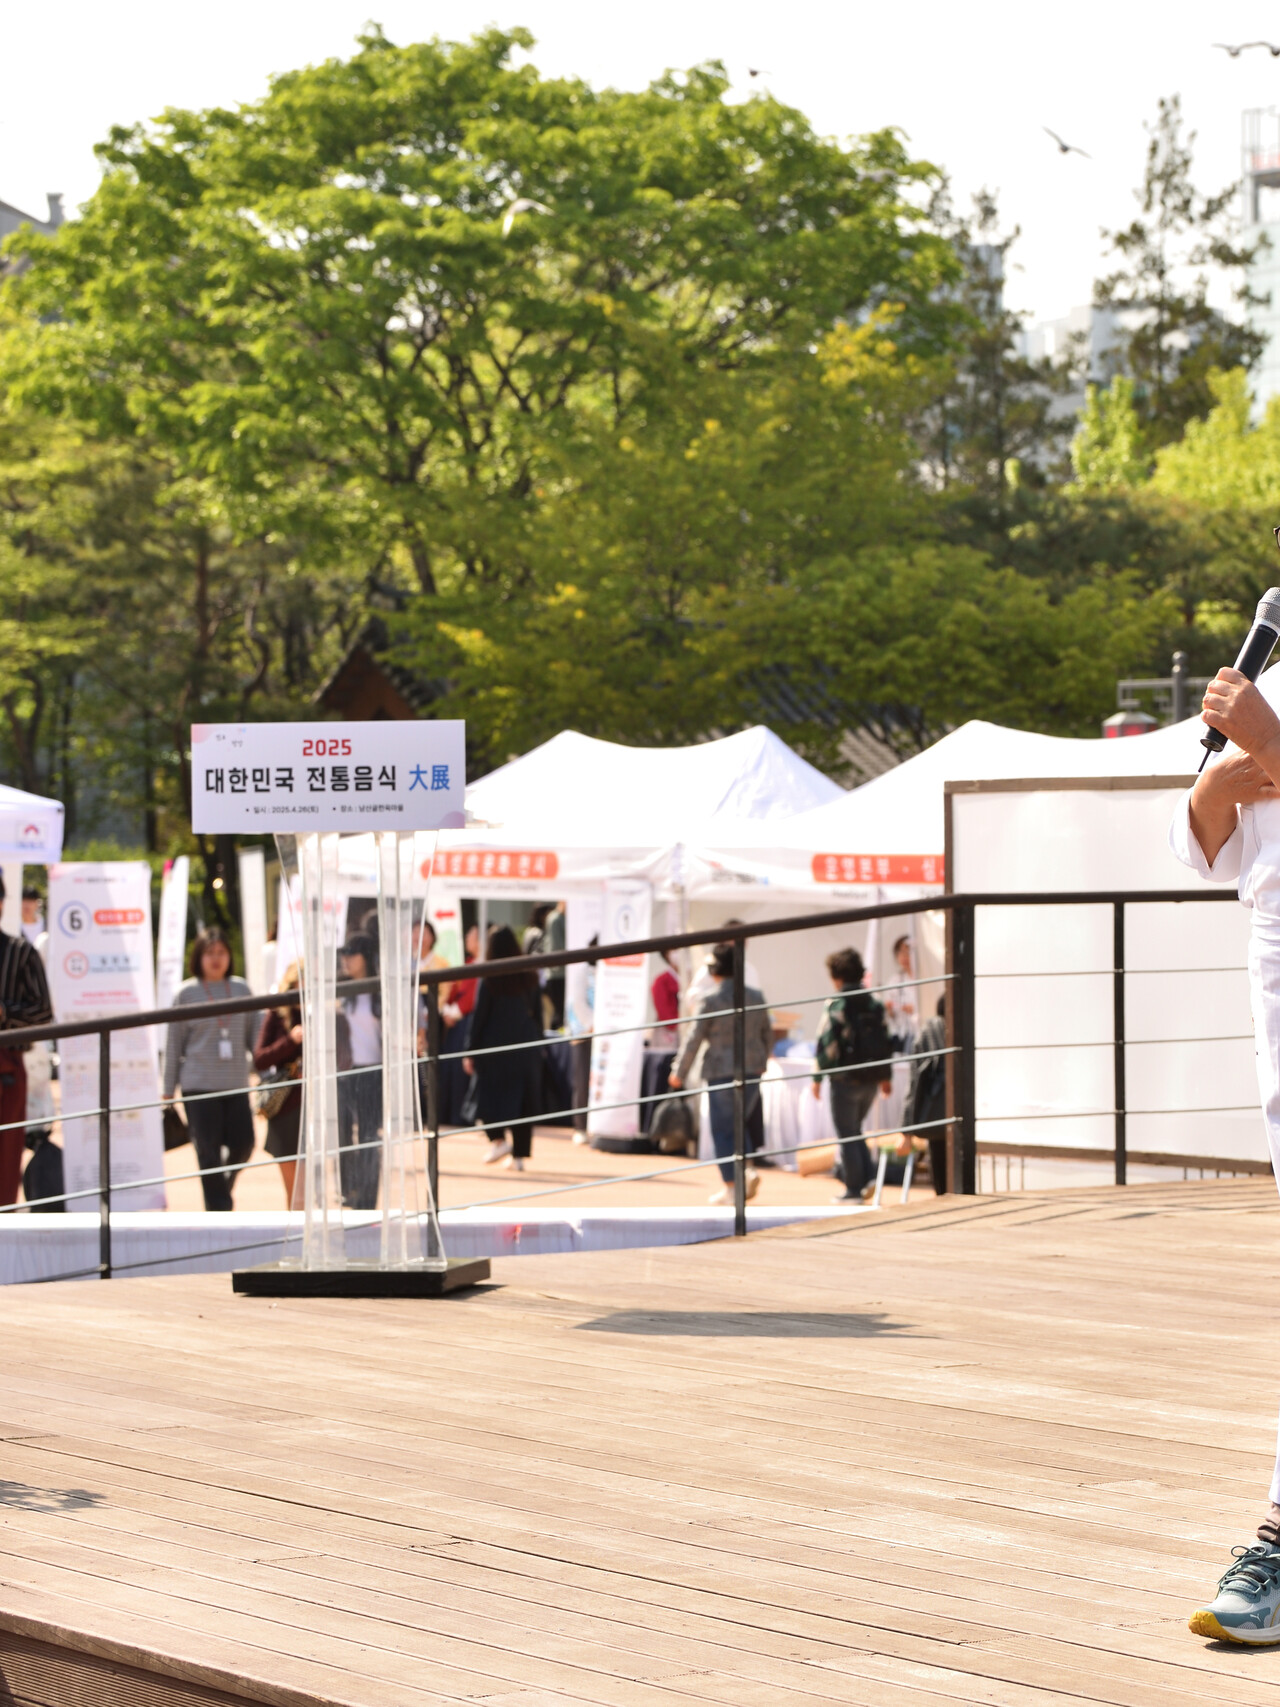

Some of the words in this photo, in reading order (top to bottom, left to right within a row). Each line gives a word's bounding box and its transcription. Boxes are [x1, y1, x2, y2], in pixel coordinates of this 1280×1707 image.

[302, 739, 353, 756] 2025
[205, 767, 295, 794] 대한민국
[307, 765, 397, 793] 전통음식
[408, 764, 451, 791] 大展
[69, 910, 83, 931] 6
